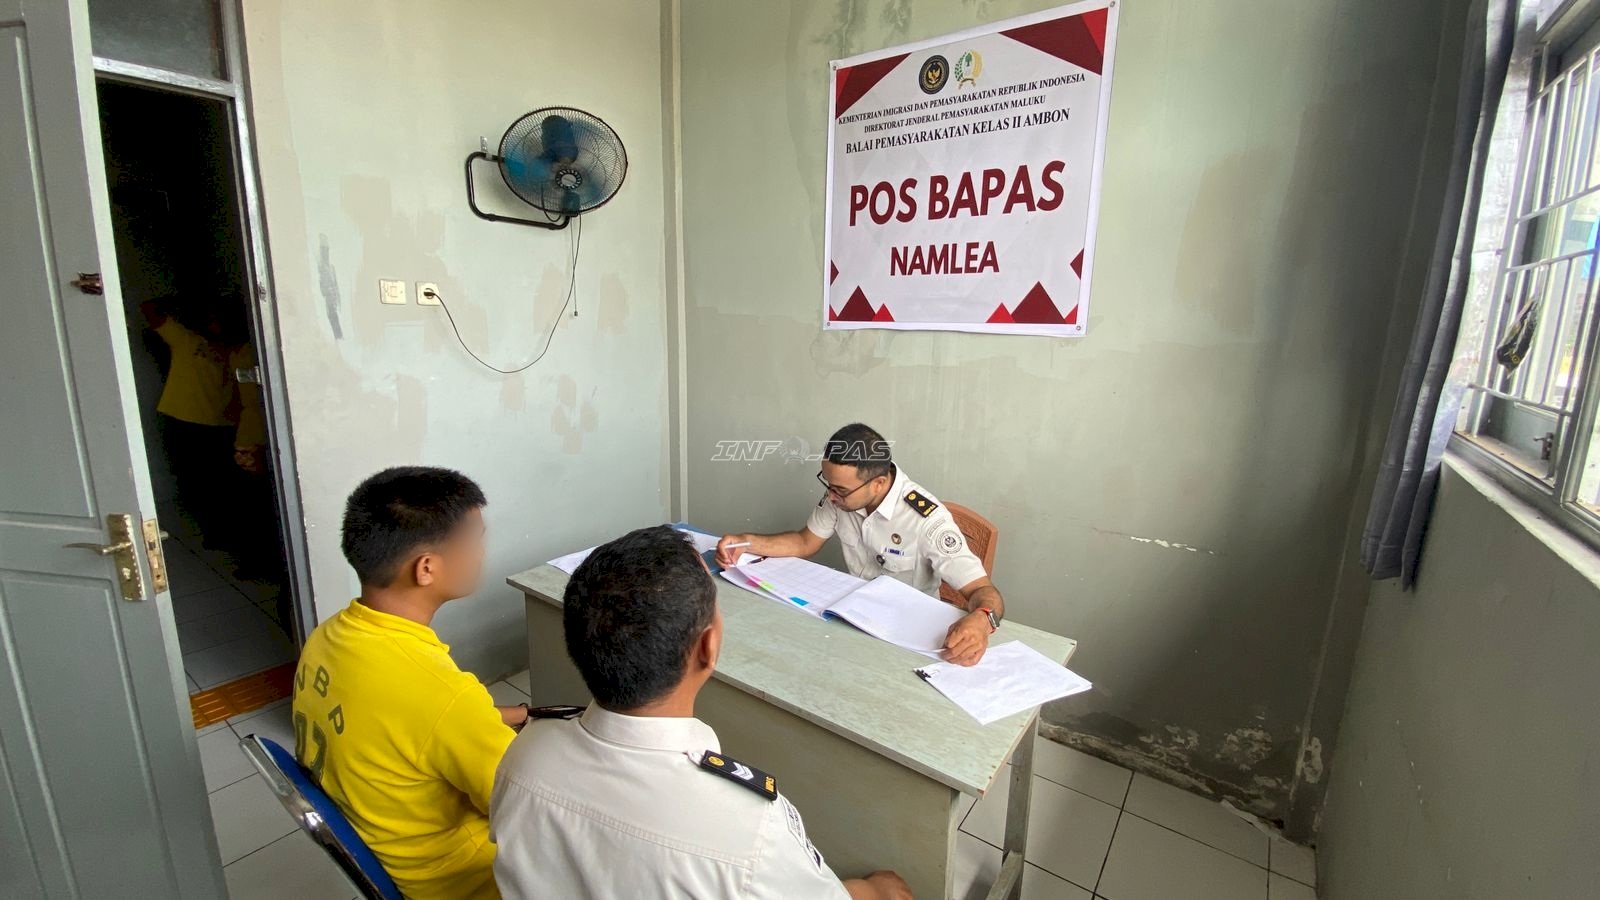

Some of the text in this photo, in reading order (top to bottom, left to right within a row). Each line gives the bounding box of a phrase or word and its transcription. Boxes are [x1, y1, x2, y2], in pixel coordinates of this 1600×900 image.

[838, 73, 1085, 124] KEMENTERIAN IMIGRASI DAN PEMASYARAKATAN REPUBLIK INDONESIA
[864, 95, 1046, 133] DIREKTORAT JENDERAL PEMASYARAKATAN MALUKU
[846, 108, 1071, 154] BALAI PEMASYARAKATAN KELAS II AMBON
[849, 160, 1066, 227] POS BAPAS
[890, 241, 1000, 276] NAMLEA
